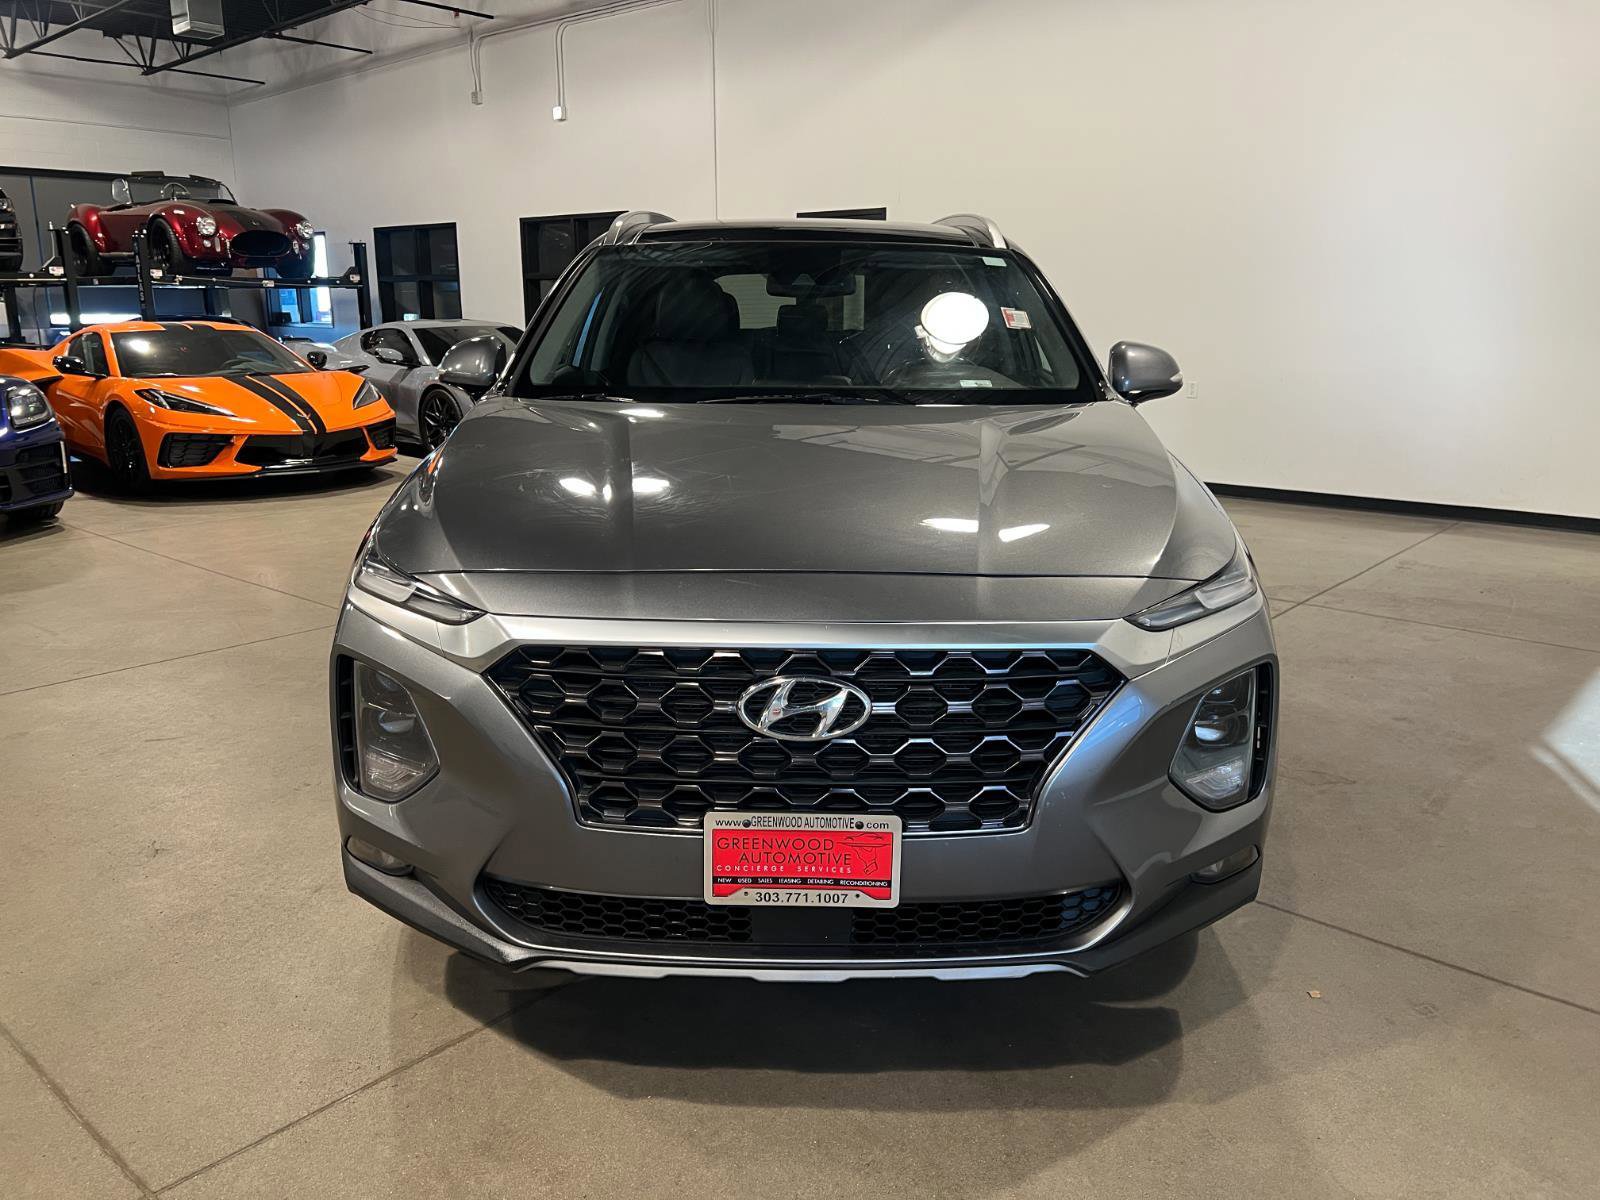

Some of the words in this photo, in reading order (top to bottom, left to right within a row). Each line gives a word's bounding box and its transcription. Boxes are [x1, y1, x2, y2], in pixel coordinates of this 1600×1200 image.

[715, 819, 742, 827] www
[751, 816, 802, 828] GREENWOOD
[804, 817, 855, 829] AUTOMOTIVE
[717, 837, 834, 851] GREENWOOD
[738, 851, 852, 865] AUTOMOTIVE
[716, 864, 784, 872] CONCIERGE
[797, 865, 851, 873] SERVICES
[839, 879, 888, 887] RECONDITIONING
[755, 892, 848, 904] 303.771.1007
